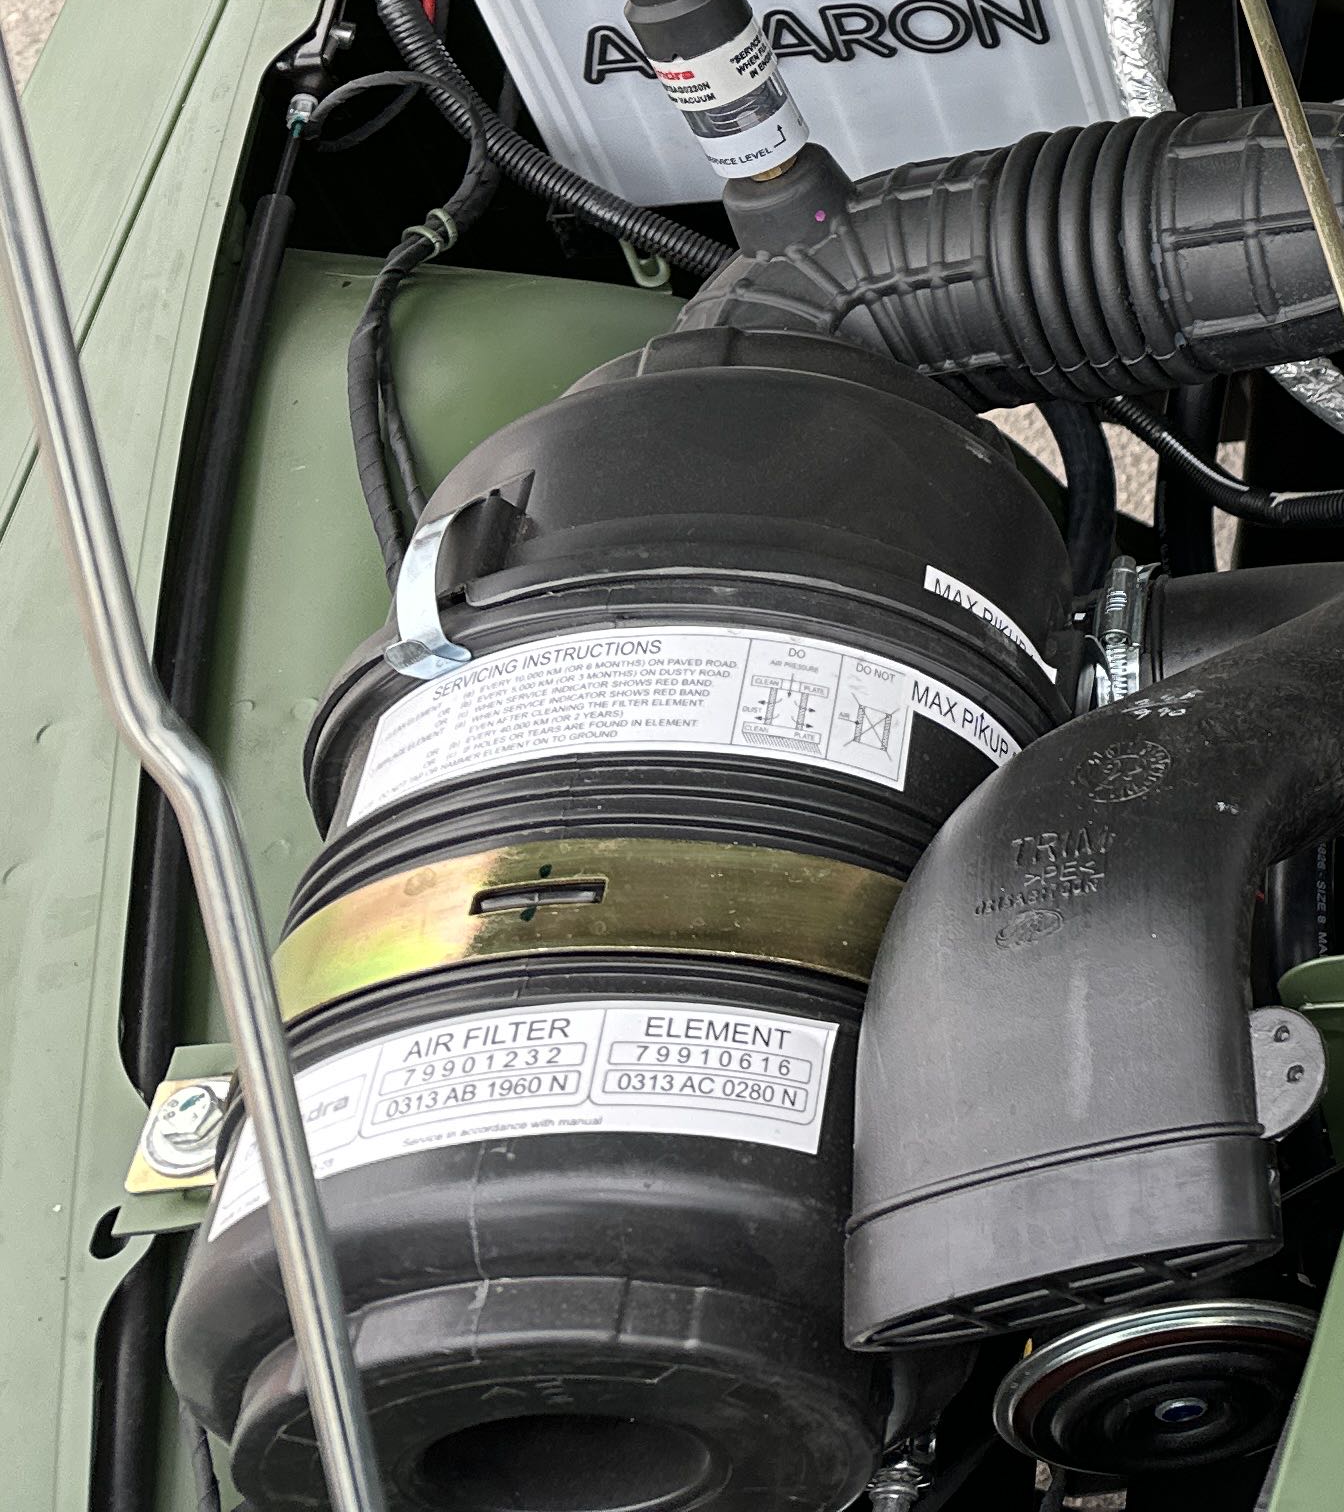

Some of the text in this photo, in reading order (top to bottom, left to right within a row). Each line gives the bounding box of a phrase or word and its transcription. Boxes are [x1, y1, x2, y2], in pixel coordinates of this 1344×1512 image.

[739, 147, 773, 165] LEVEL
[432, 640, 662, 701] SERVICING INSTRUCTIONS
[788, 649, 806, 659] DO
[856, 663, 896, 683] DO NOT
[911, 680, 1008, 758] MAX PIKUP
[402, 1018, 571, 1062] AIR FILTER
[644, 1016, 791, 1050] ELEMENT
[386, 1074, 568, 1118] 0313 AB 1960 N
[617, 1073, 798, 1107] 0313 AC 0280 N
